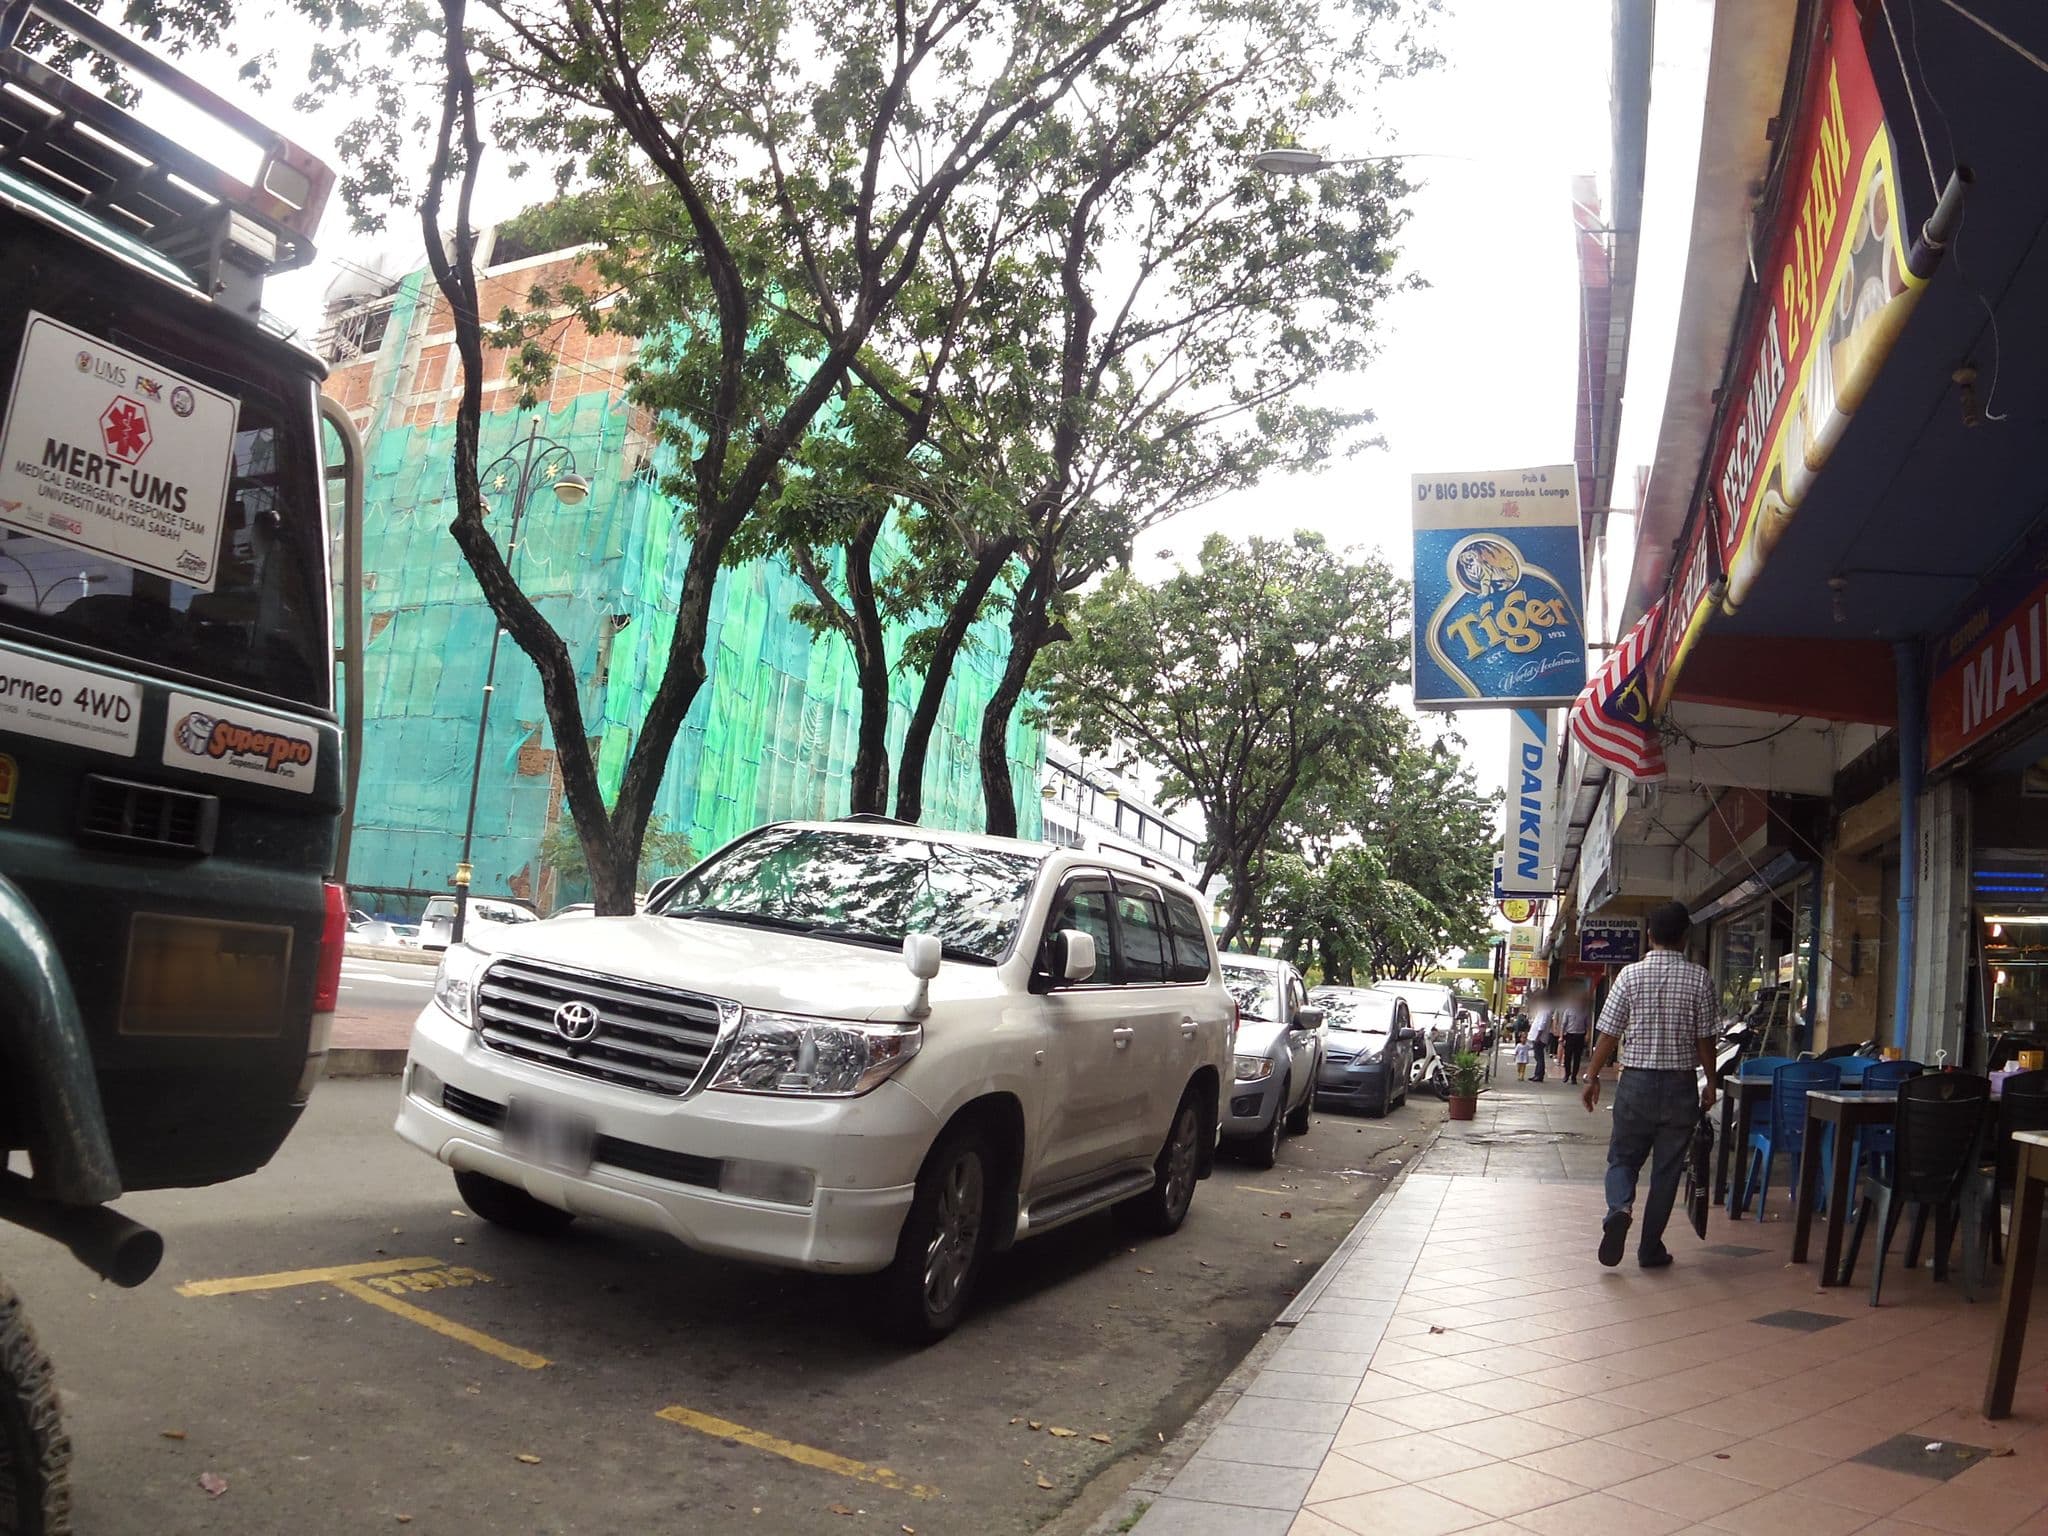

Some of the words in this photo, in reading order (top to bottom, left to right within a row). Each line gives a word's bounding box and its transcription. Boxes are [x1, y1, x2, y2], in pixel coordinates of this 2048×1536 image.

[95, 357, 127, 384] UMS
[1722, 305, 1785, 548] SEGAMA
[16, 460, 62, 487] MEDICAL
[64, 477, 126, 507] EMERGENCY
[128, 499, 177, 526] RESPONSE
[179, 517, 205, 536] TEAM
[42, 437, 188, 513] MERT-UMS
[1435, 483, 1458, 500] BIG
[1461, 481, 1496, 499] BOSS
[1500, 488, 1536, 497] Karaoke
[1539, 487, 1570, 499] Lounge
[1522, 474, 1538, 483] Pub
[38, 484, 94, 514] UNIVERSITI
[95, 503, 146, 531] MALAYSIA
[148, 521, 181, 542] SABAH
[1447, 590, 1570, 662] Tiger
[1962, 592, 2048, 736] MAI
[73, 686, 132, 723] 4WD
[1517, 743, 1544, 880] DAIKIN
